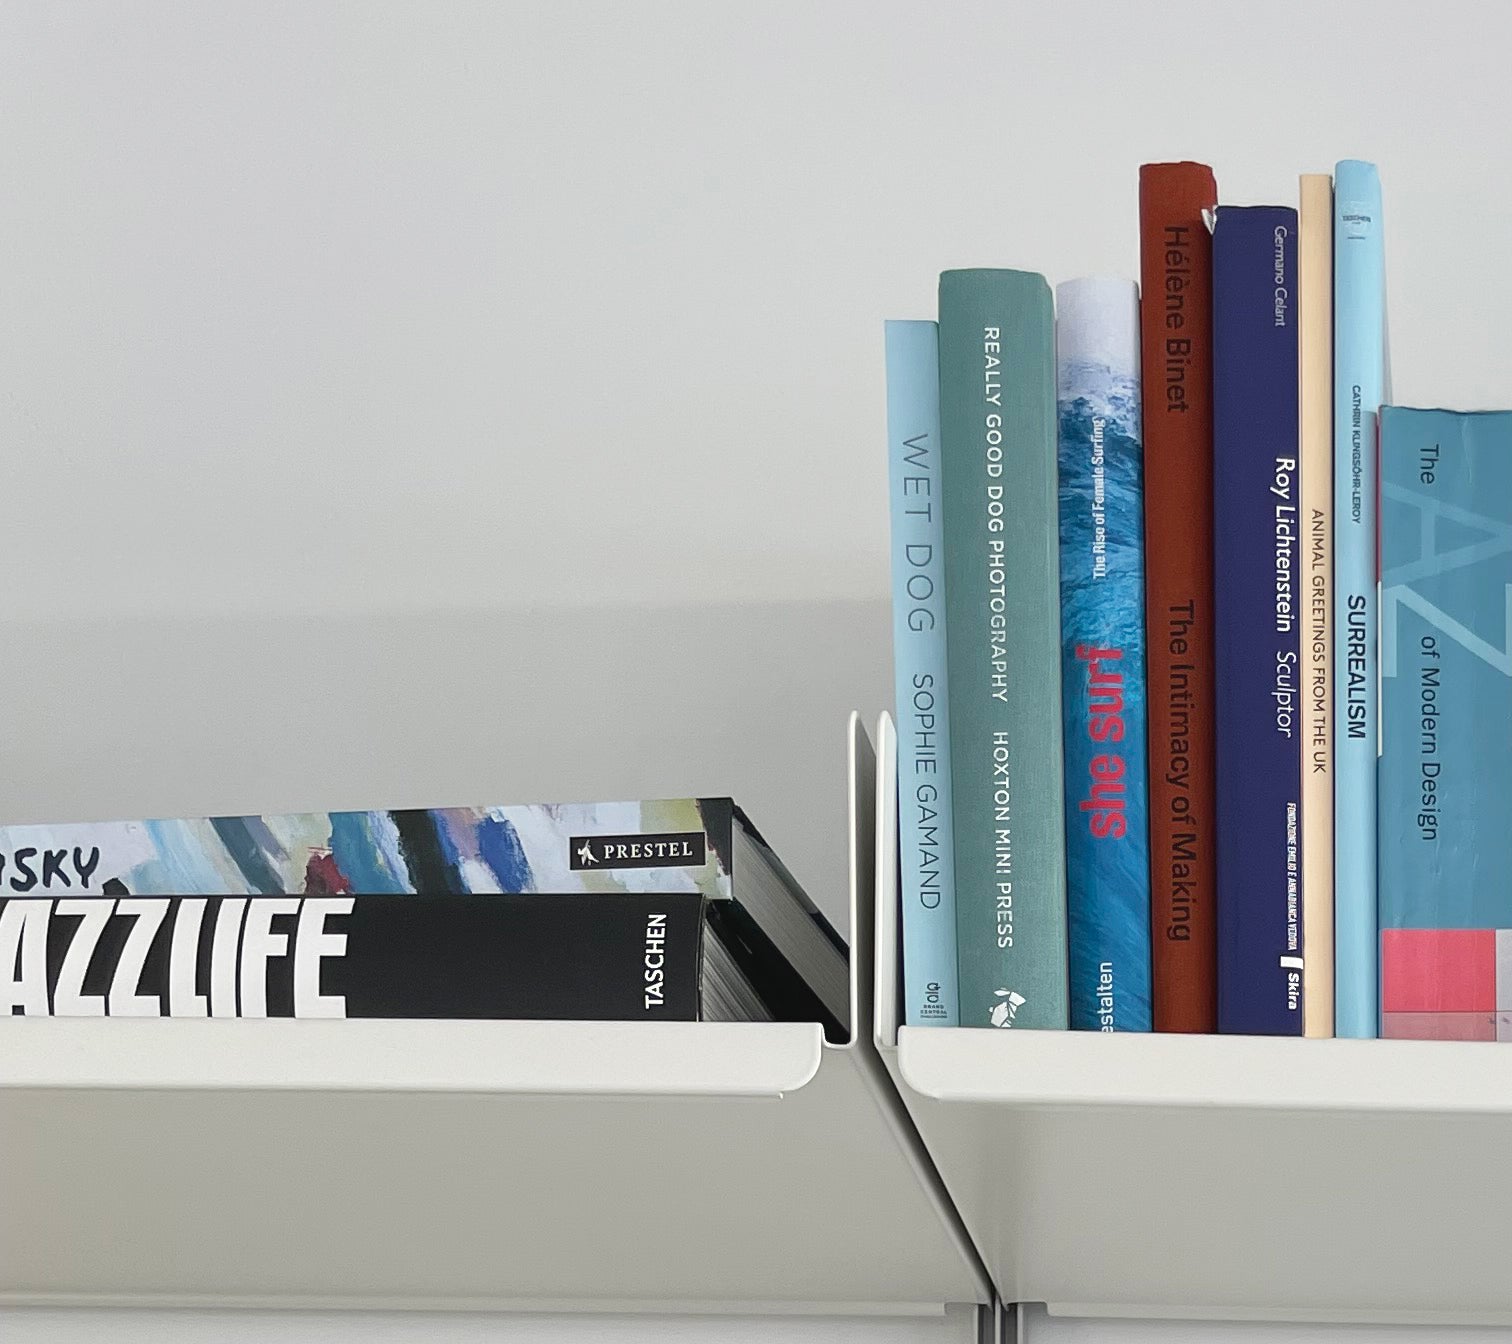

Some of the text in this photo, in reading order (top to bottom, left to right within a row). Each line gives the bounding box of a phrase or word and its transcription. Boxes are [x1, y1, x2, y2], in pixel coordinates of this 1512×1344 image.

[1275, 226, 1287, 326] Germano Celant
[1353, 385, 1361, 427] CATHRIN
[1091, 418, 1107, 580] The Rise of Female Surfing
[1420, 444, 1439, 484] The
[1163, 227, 1196, 940] Hélène Binet The Intimacy of Making
[1270, 458, 1296, 738] Roy Lichtenstein Sculptor
[903, 434, 940, 909] WET DOG SOPHIE GAMAND
[985, 327, 1012, 947] REALLY GOOD DOG PHOTOGRAPHY HOXTON MINI PRESS
[1312, 509, 1326, 773] ANIMAL GREETINGS FROM THE UK
[1348, 595, 1366, 738] SURREALISM
[1422, 637, 1440, 659] of
[1076, 644, 1127, 839] she surf
[1422, 668, 1440, 753] Modern
[604, 842, 692, 859] PRESTEL
[1418, 763, 1440, 840] Design
[645, 915, 666, 1009] TASCHEN
[1289, 973, 1299, 1009] Skira
